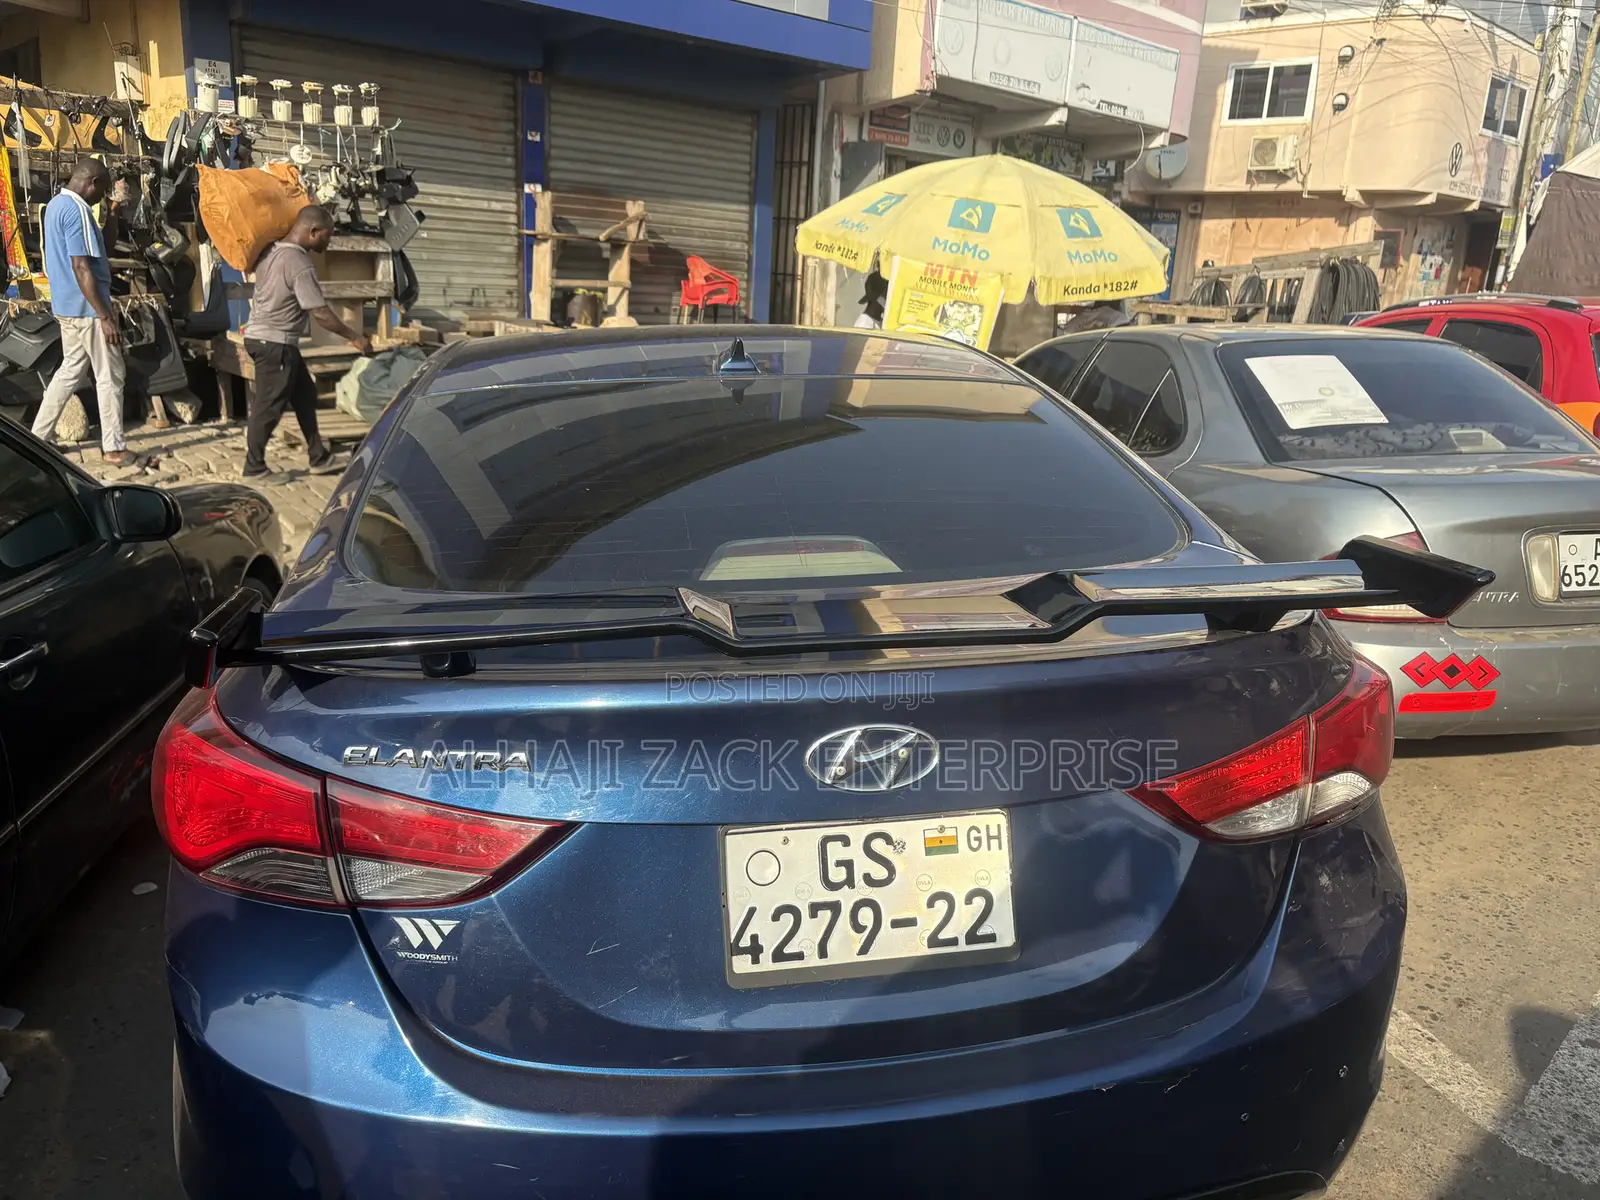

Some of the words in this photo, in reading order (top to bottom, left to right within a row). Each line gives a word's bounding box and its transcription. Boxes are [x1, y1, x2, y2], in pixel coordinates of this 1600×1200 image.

[931, 236, 990, 261] MoMo
[1067, 249, 1118, 264] MoMo
[919, 275, 947, 288] MOBILE
[949, 282, 978, 293] MONEY
[923, 262, 978, 287] MTN
[1063, 282, 1101, 296] Kanda
[343, 746, 532, 771] ELANTRA
[818, 830, 897, 892] GS
[966, 823, 1003, 853] GH
[731, 887, 997, 965] 4279-22
[396, 951, 458, 962] WOODYSMITH
